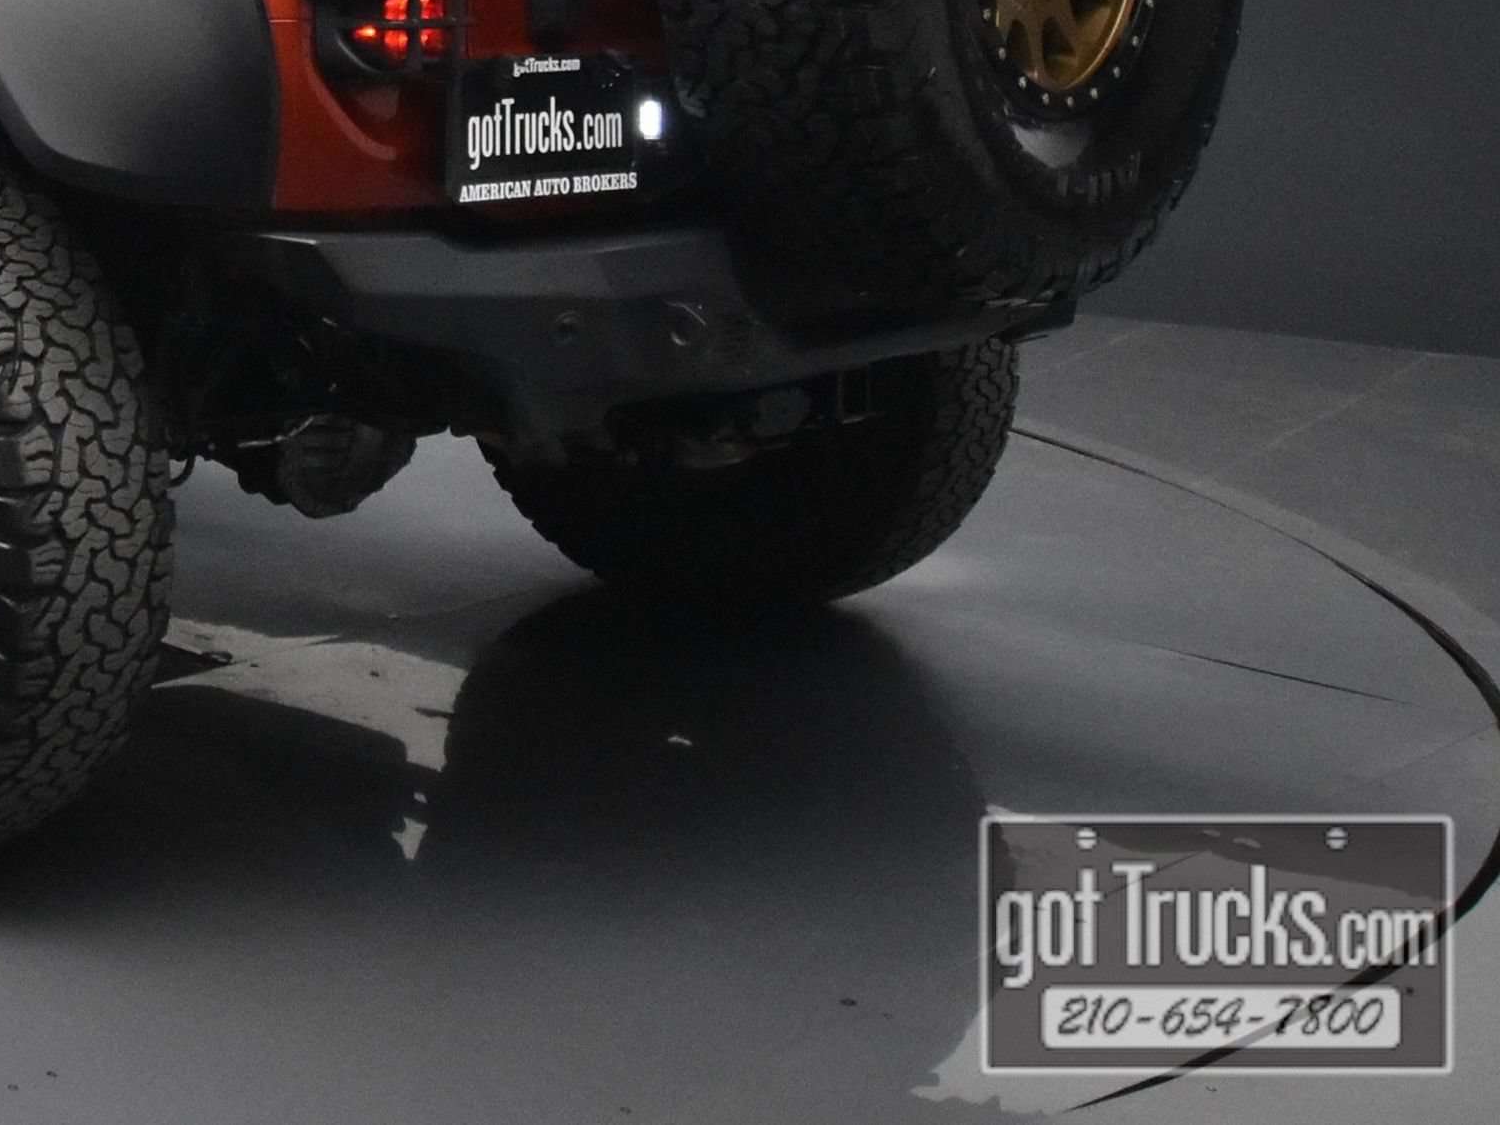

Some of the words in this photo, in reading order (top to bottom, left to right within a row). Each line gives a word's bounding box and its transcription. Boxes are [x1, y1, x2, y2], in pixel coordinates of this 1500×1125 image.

[467, 96, 623, 171] gotTrucks.com
[459, 179, 532, 203] AMERICAN
[533, 176, 571, 197] AUTO
[572, 171, 638, 194] BROKERS
